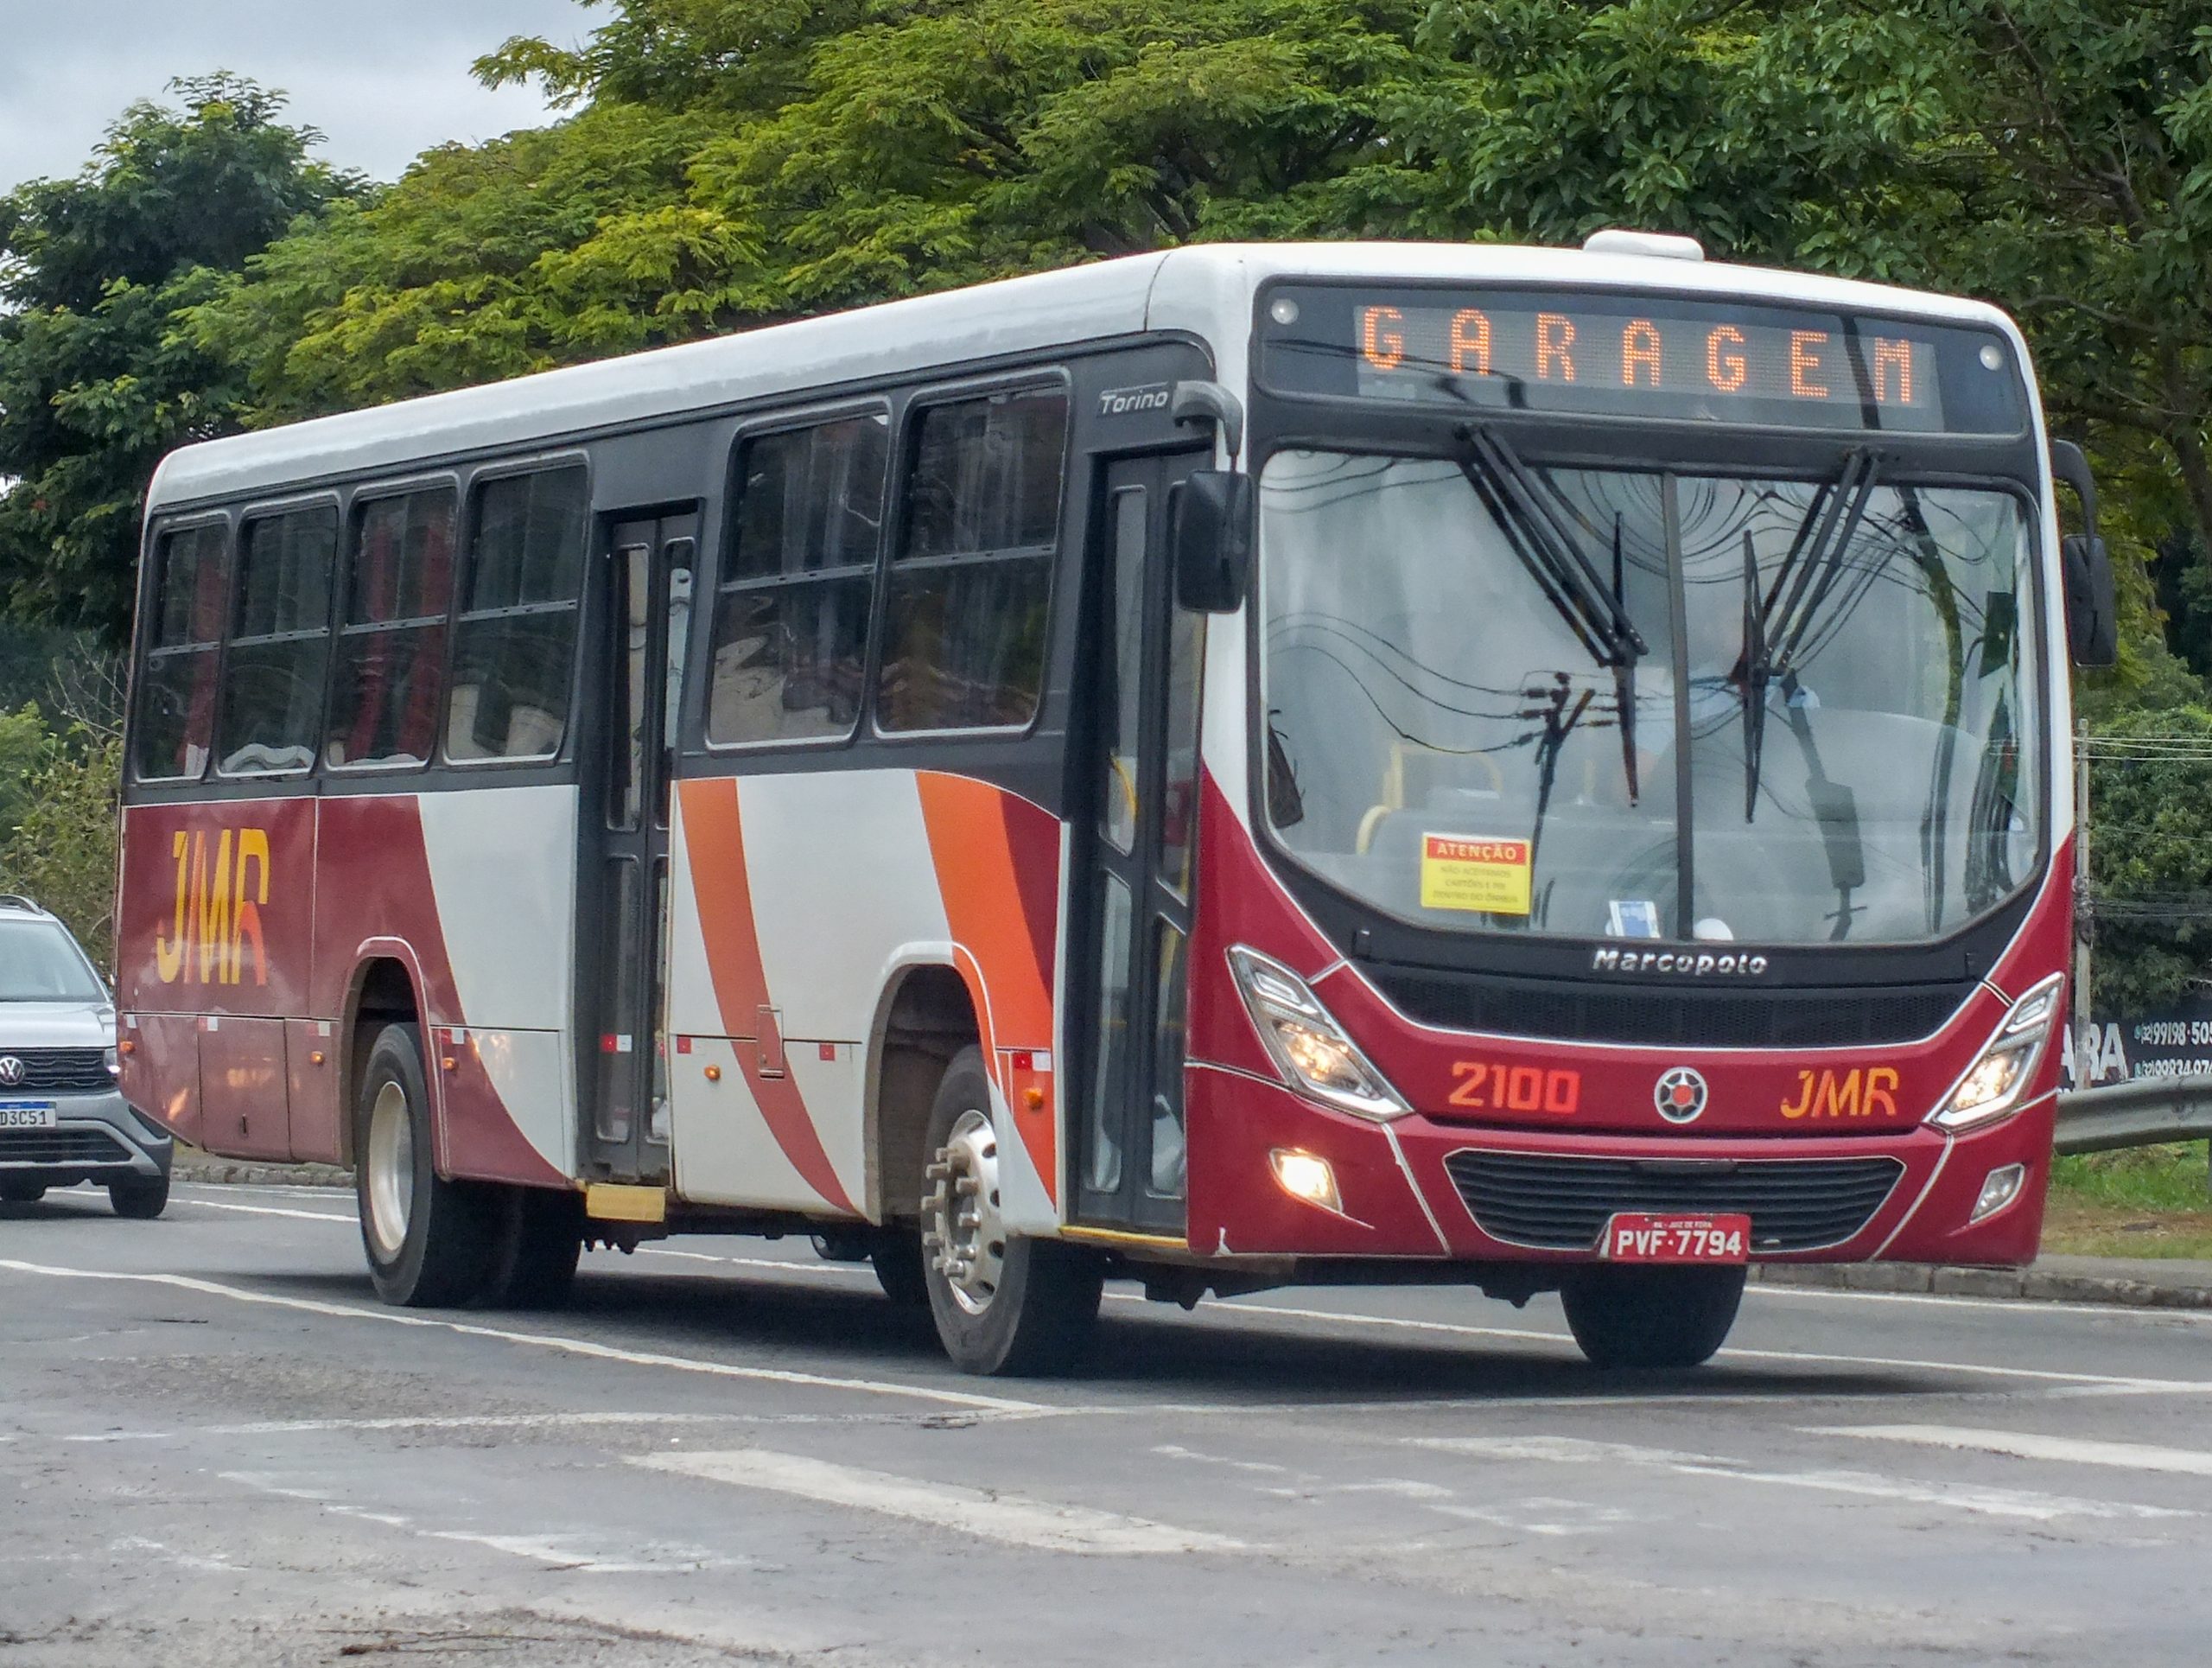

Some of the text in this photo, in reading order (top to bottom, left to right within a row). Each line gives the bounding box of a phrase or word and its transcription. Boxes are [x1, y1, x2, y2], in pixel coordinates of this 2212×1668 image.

[1363, 305, 1912, 404] GARAGEM
[1101, 390, 1168, 415] Torino
[1436, 842, 1518, 861] ATENÇÃO
[156, 828, 270, 986] JMR
[1592, 947, 1768, 976] Marcopolo
[1449, 1061, 1580, 1114] 2100
[1780, 1067, 1898, 1119] JMR
